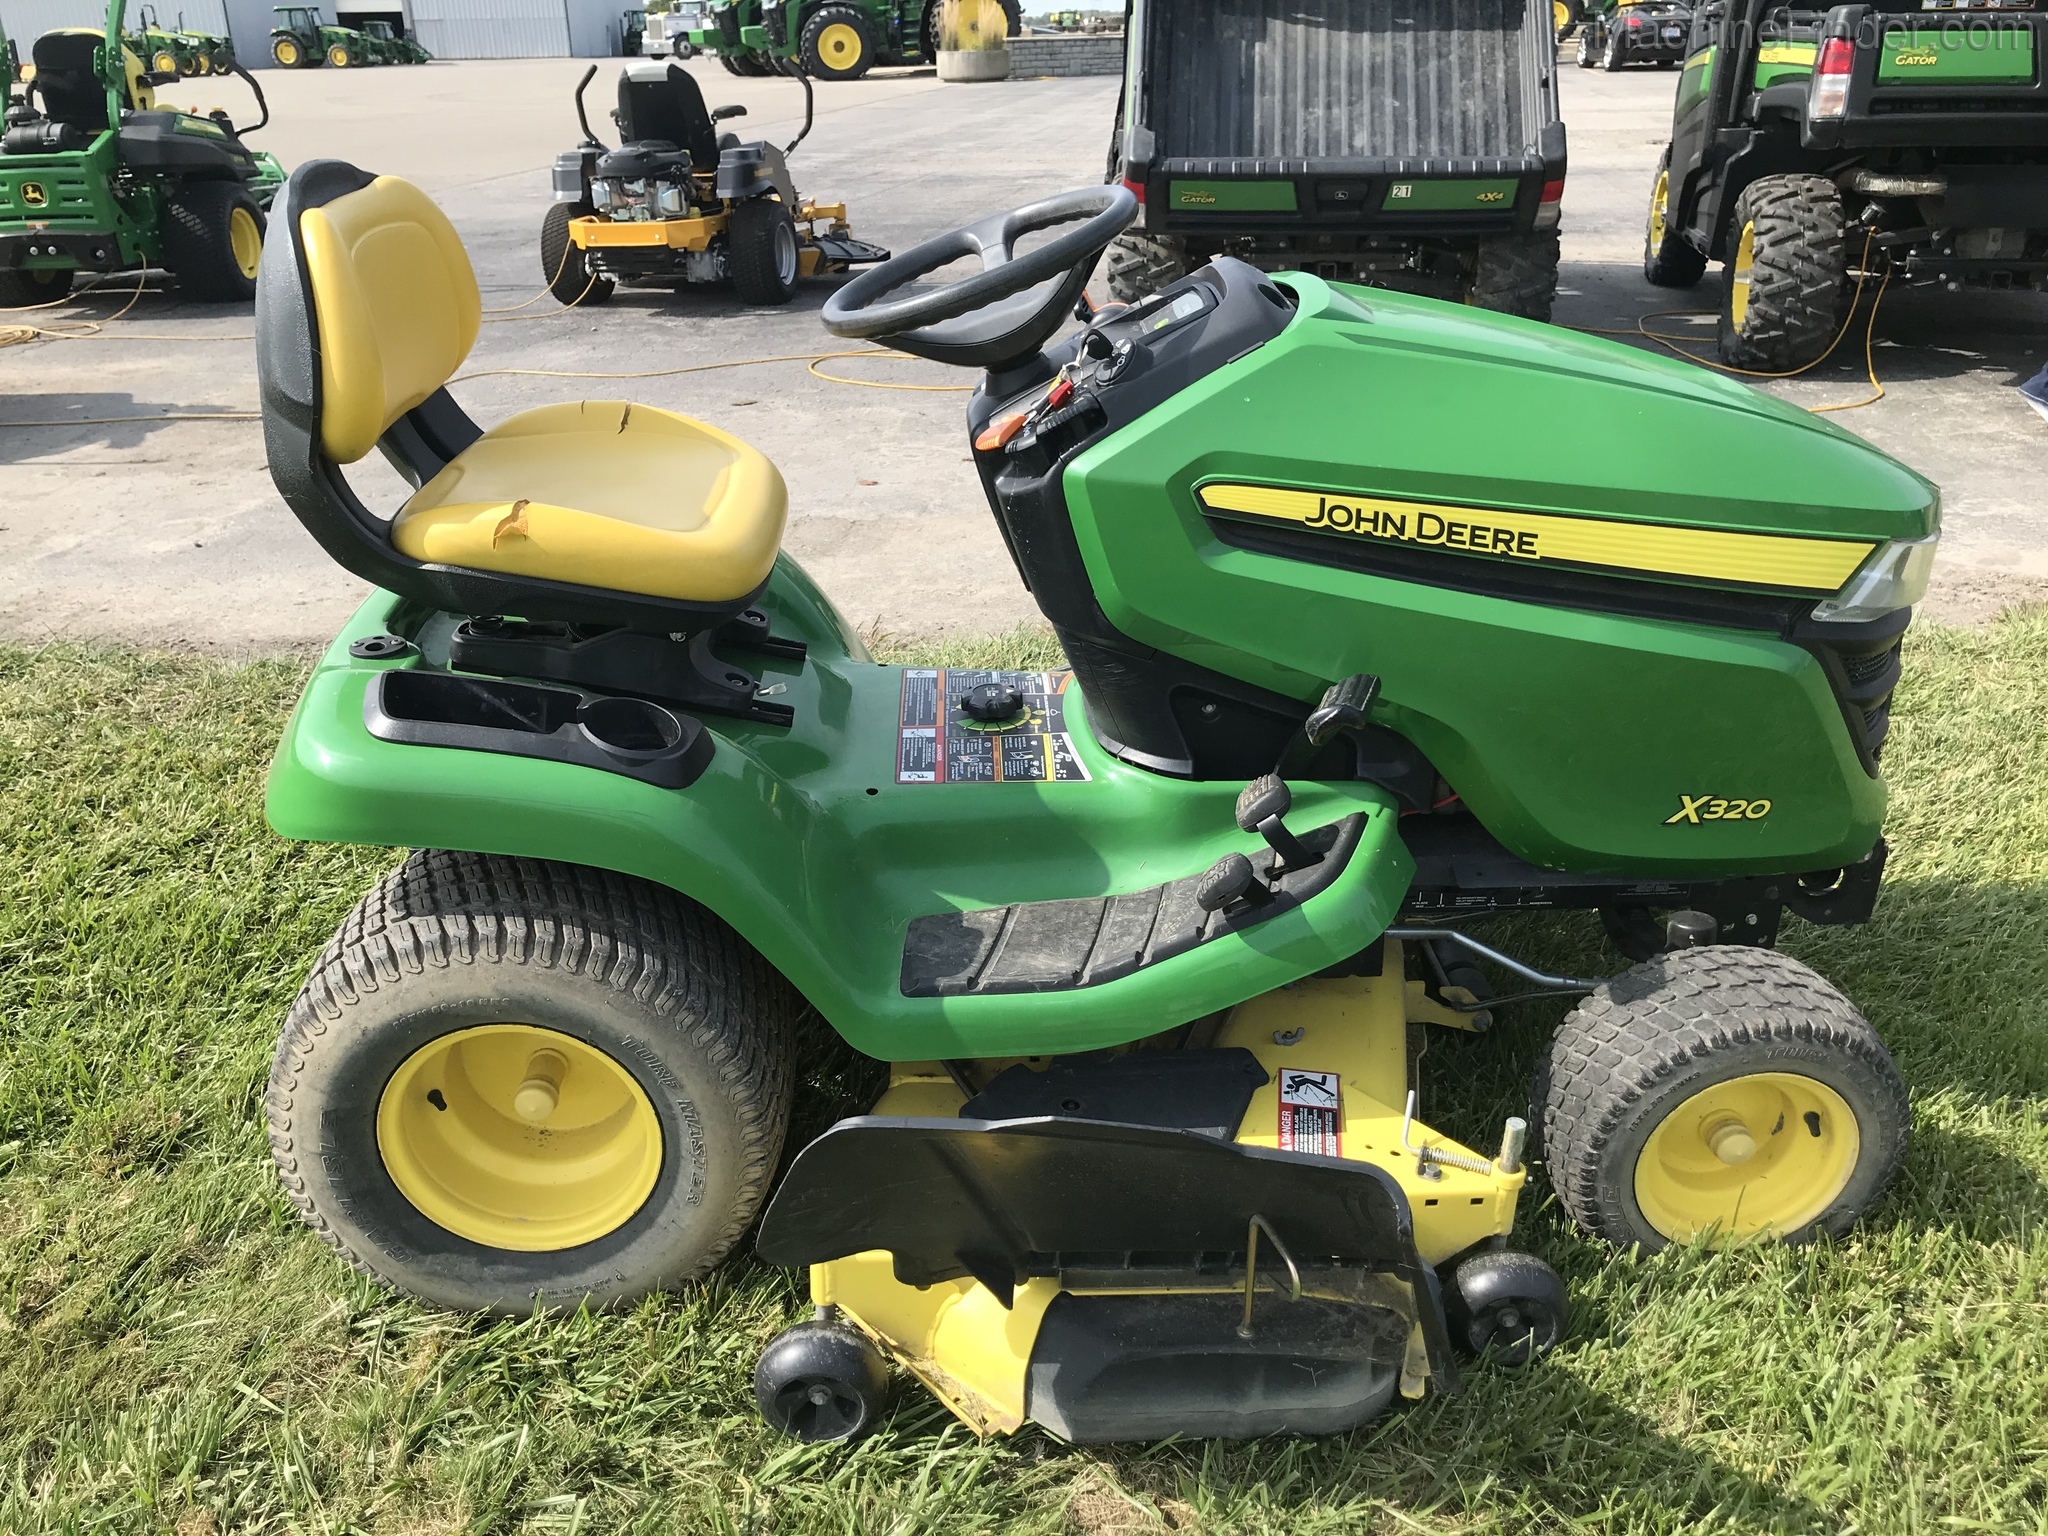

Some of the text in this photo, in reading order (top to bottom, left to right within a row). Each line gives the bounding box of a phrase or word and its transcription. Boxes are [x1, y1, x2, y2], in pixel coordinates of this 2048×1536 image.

[1895, 55, 1938, 66] GATOR
[1181, 196, 1216, 204] GATOR
[1393, 186, 1411, 197] 21
[1304, 497, 1539, 557] JOHN DEERE
[1663, 794, 1773, 824] X320
[621, 1034, 708, 1207] TURF MASTER
[1281, 1110, 1291, 1144] DANGER
